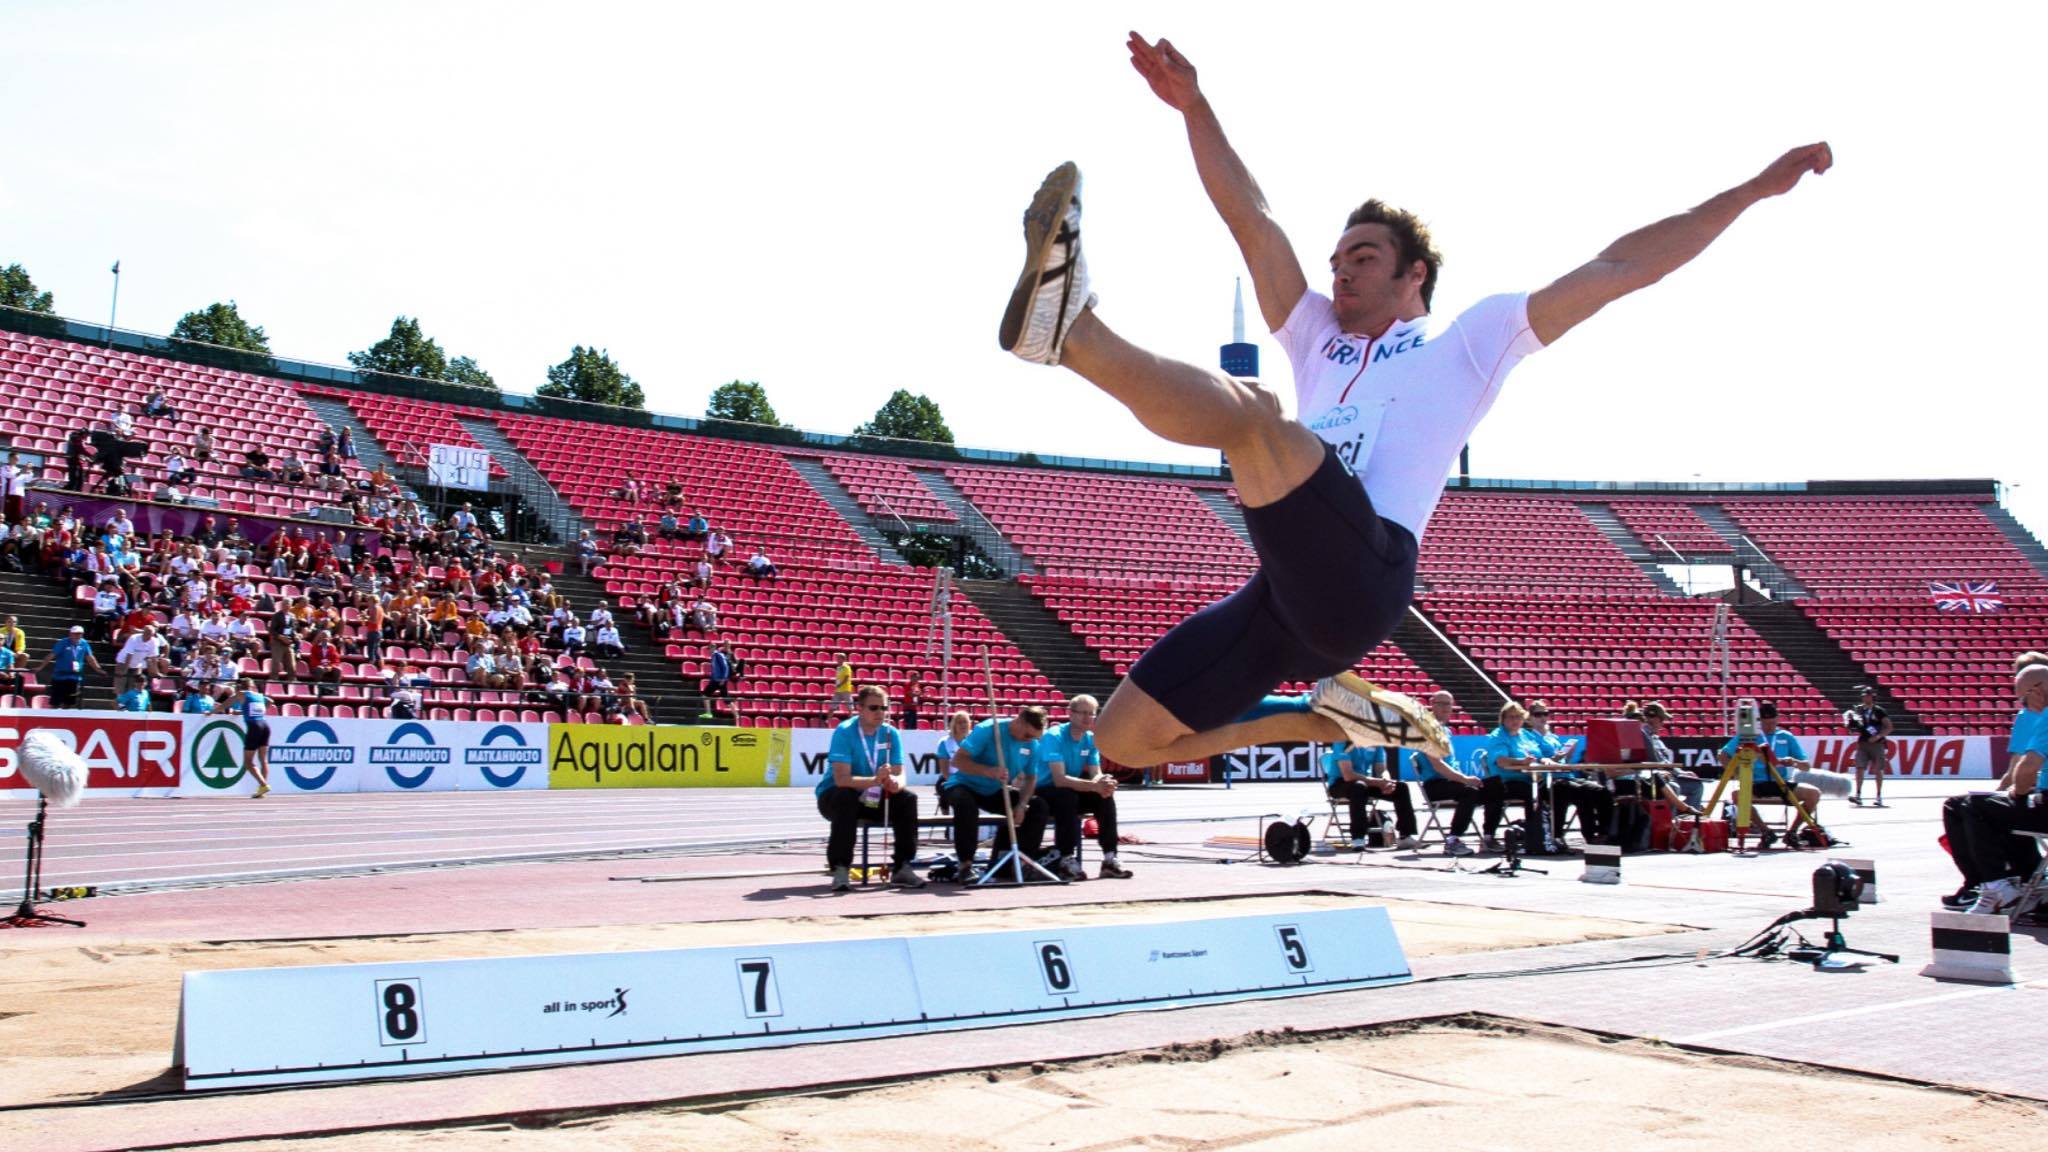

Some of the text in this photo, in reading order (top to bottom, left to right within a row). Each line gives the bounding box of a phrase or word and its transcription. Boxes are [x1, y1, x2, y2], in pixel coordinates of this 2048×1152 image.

[270, 749, 351, 762] MATKAHUOLTO
[372, 749, 448, 762] MATKAHUOLTO
[467, 749, 539, 763] MATKAHUOLTO
[715, 735, 729, 772] L
[1041, 944, 1071, 990] 6
[1279, 928, 1307, 969] 5
[741, 962, 770, 1012] 7
[384, 983, 418, 1040] 8
[543, 1002, 560, 1013] all
[564, 1001, 577, 1012] in
